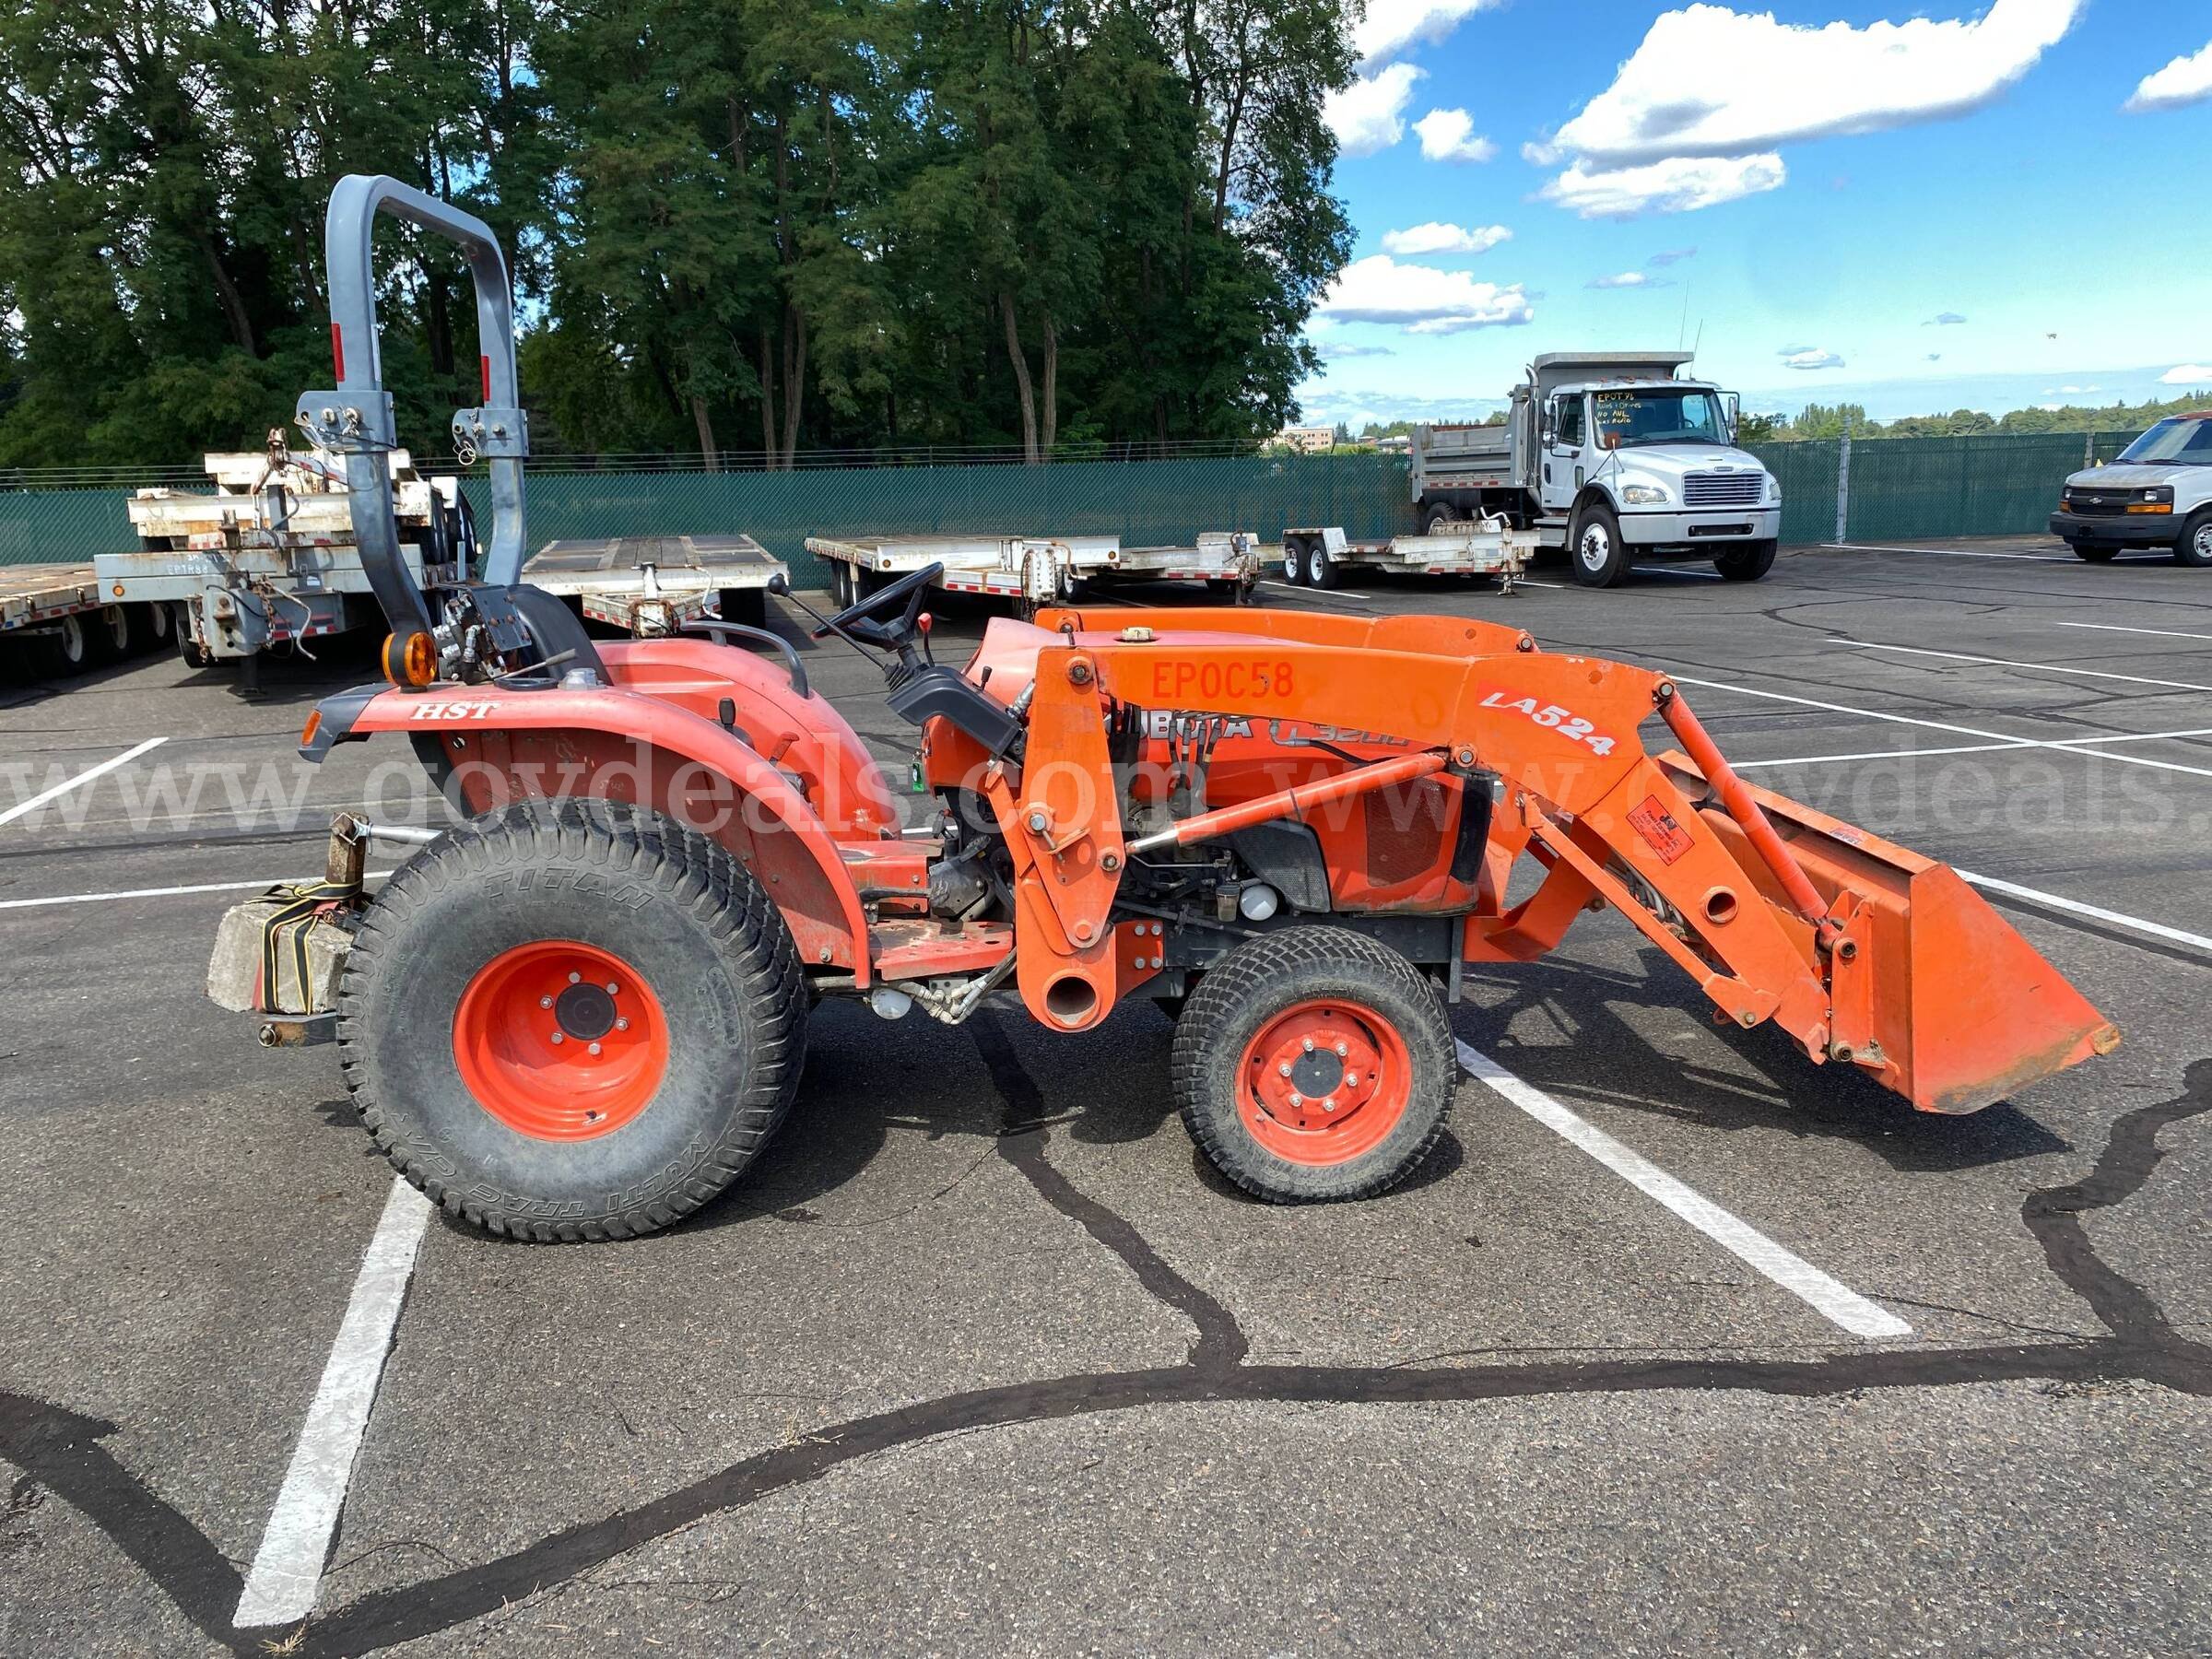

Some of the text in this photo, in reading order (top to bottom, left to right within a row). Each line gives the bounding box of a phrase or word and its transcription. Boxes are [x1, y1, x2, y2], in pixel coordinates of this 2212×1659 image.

[409, 701, 501, 721] HST
[1479, 692, 1617, 756] LA524
[484, 867, 655, 911] TITAN
